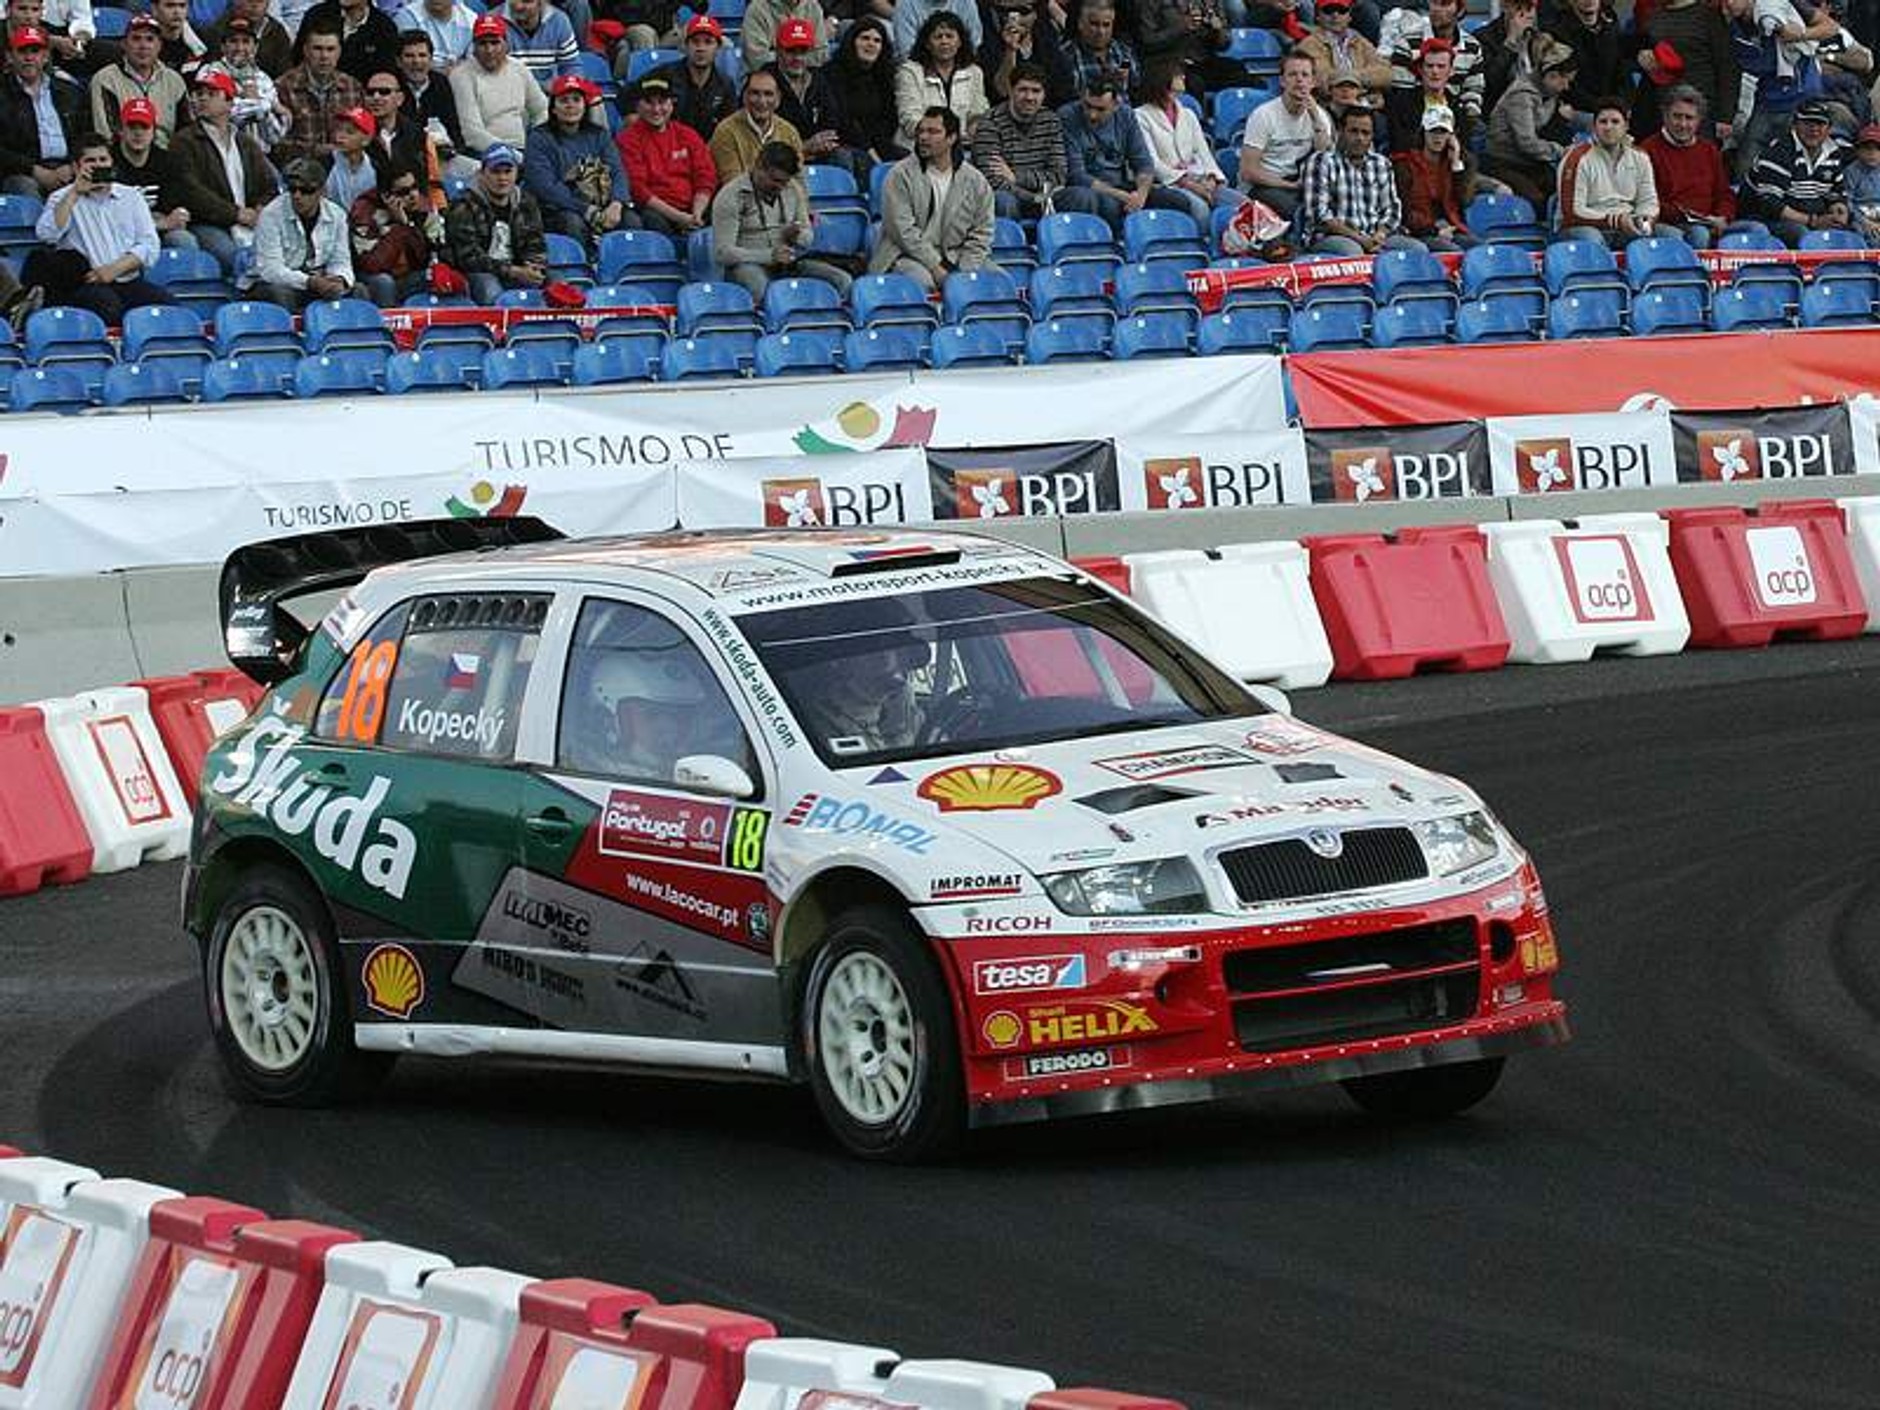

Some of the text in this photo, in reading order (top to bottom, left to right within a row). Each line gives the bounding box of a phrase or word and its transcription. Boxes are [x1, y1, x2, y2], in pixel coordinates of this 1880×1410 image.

[475, 433, 733, 470] TURISMO DE
[1576, 443, 1651, 489] BPI
[1757, 434, 1835, 479] BPI
[1019, 471, 1096, 516] BPI
[1208, 462, 1284, 506] BPI
[1393, 451, 1471, 500] BPI
[264, 500, 413, 527] TURISMO DE
[828, 482, 904, 525] BPI
[1588, 582, 1631, 611] acp
[1767, 570, 1810, 597] acp
[336, 639, 398, 746] 18
[703, 607, 797, 749] www.skoda-auto.com
[399, 697, 505, 748] Kopecký
[606, 809, 687, 840] Portugal
[733, 810, 766, 869] 18
[930, 874, 1022, 891] IMPROMAT
[967, 916, 1051, 932] RICOH
[981, 963, 1051, 988] tesa
[1028, 1002, 1158, 1044] HELIX
[1029, 1050, 1107, 1074] FERODO
[153, 1347, 201, 1401] acp
